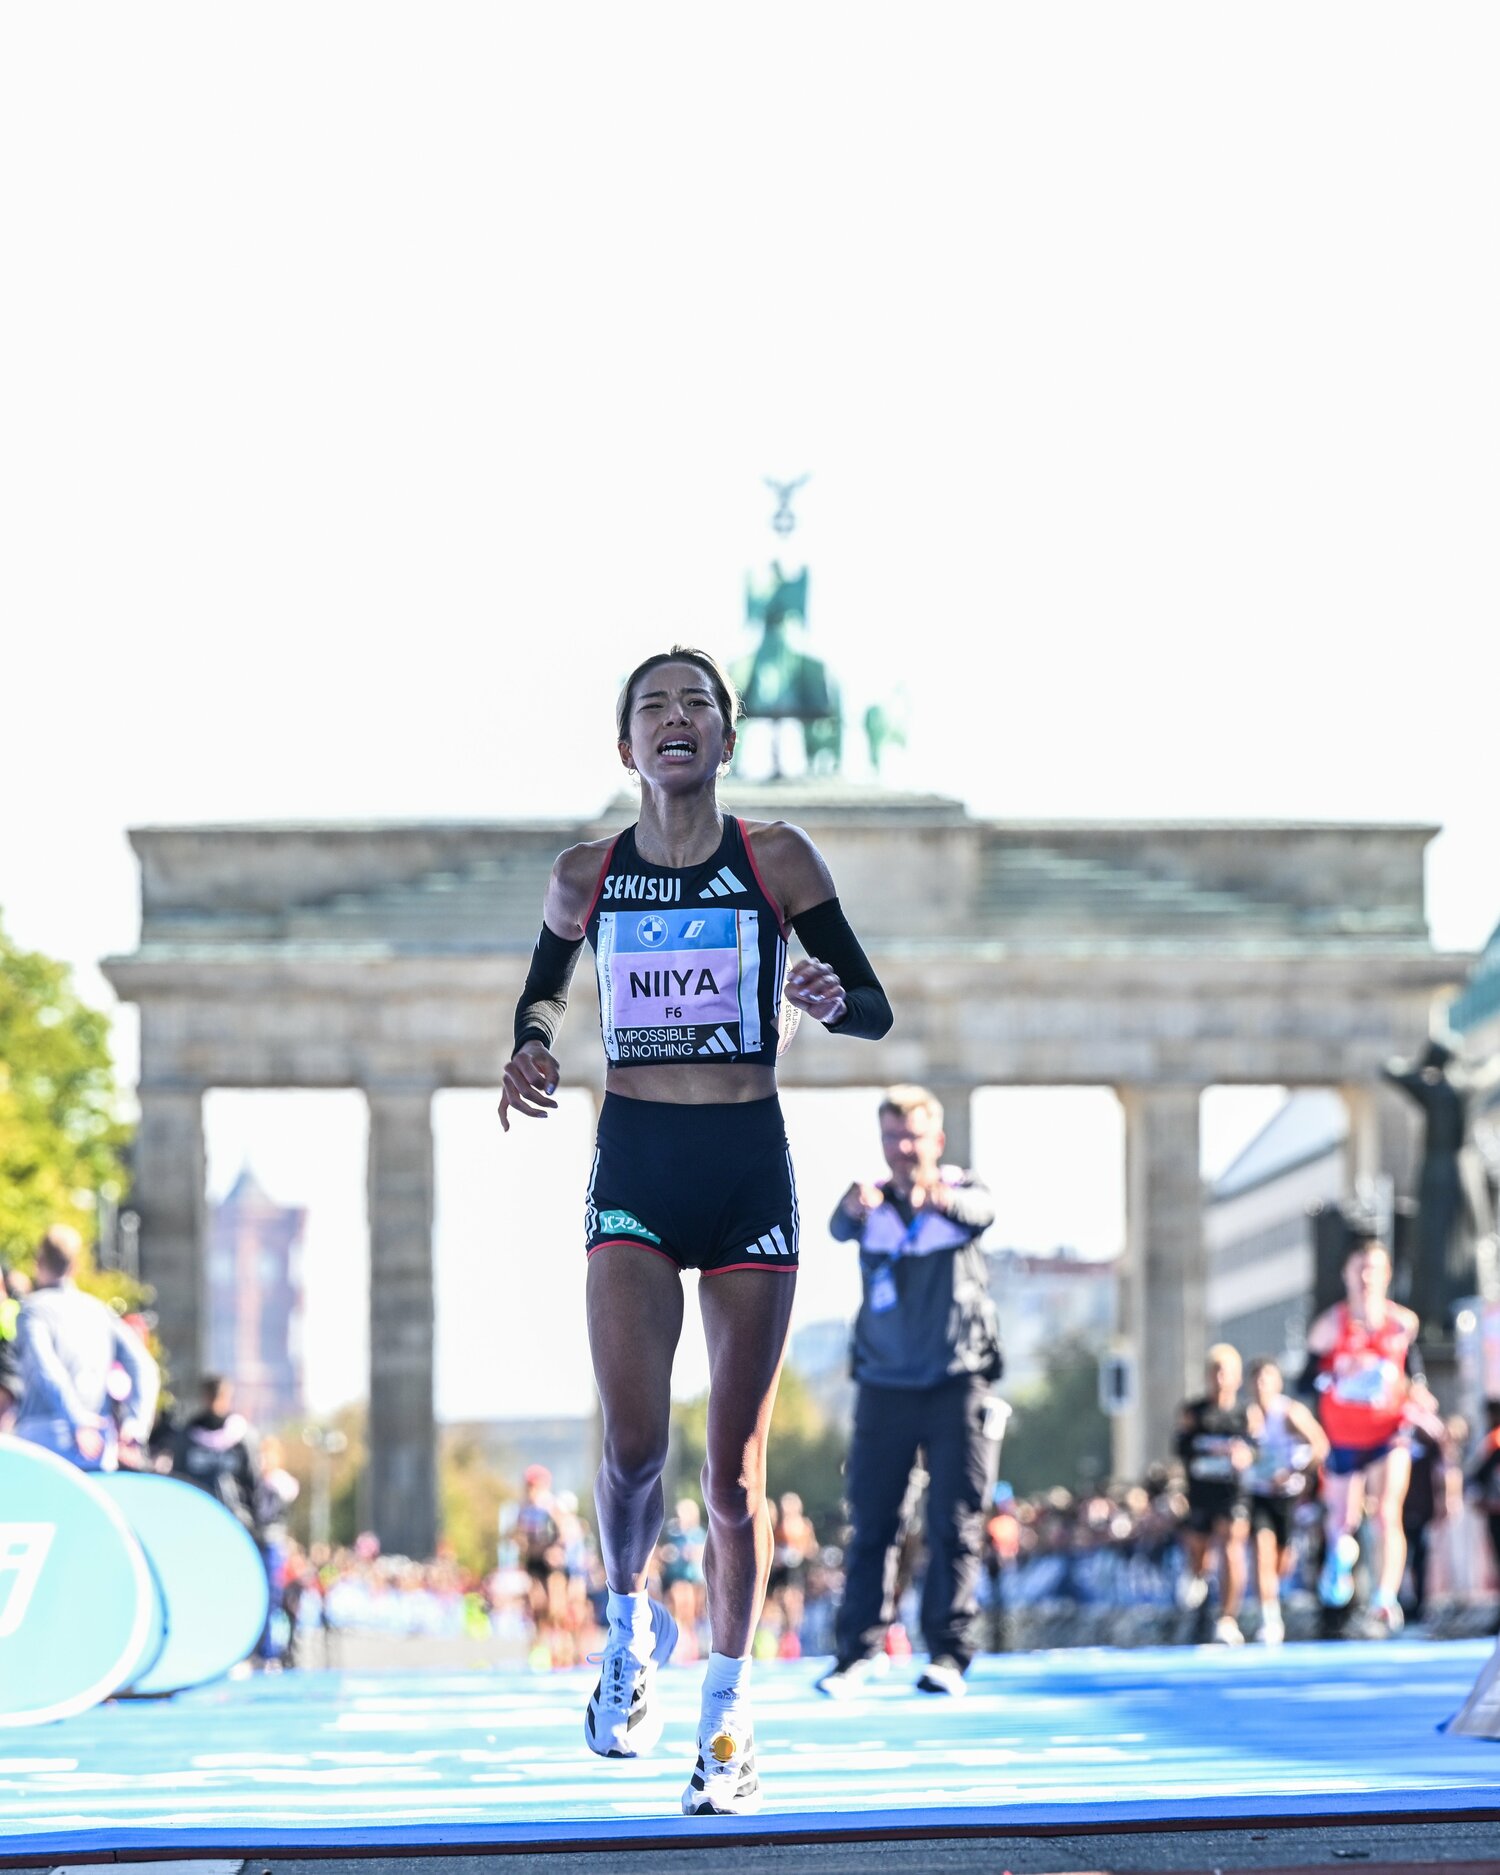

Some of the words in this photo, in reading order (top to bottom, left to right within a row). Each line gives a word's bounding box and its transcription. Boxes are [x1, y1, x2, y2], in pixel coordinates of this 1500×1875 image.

[603, 874, 681, 902] SEKISUI
[604, 974, 612, 992] 2023
[630, 968, 720, 998] NIIYA
[665, 1006, 682, 1019] F6
[616, 1027, 697, 1043] IMPOSSIBLE
[620, 1045, 630, 1058] IS
[631, 1042, 694, 1058] NOTHING
